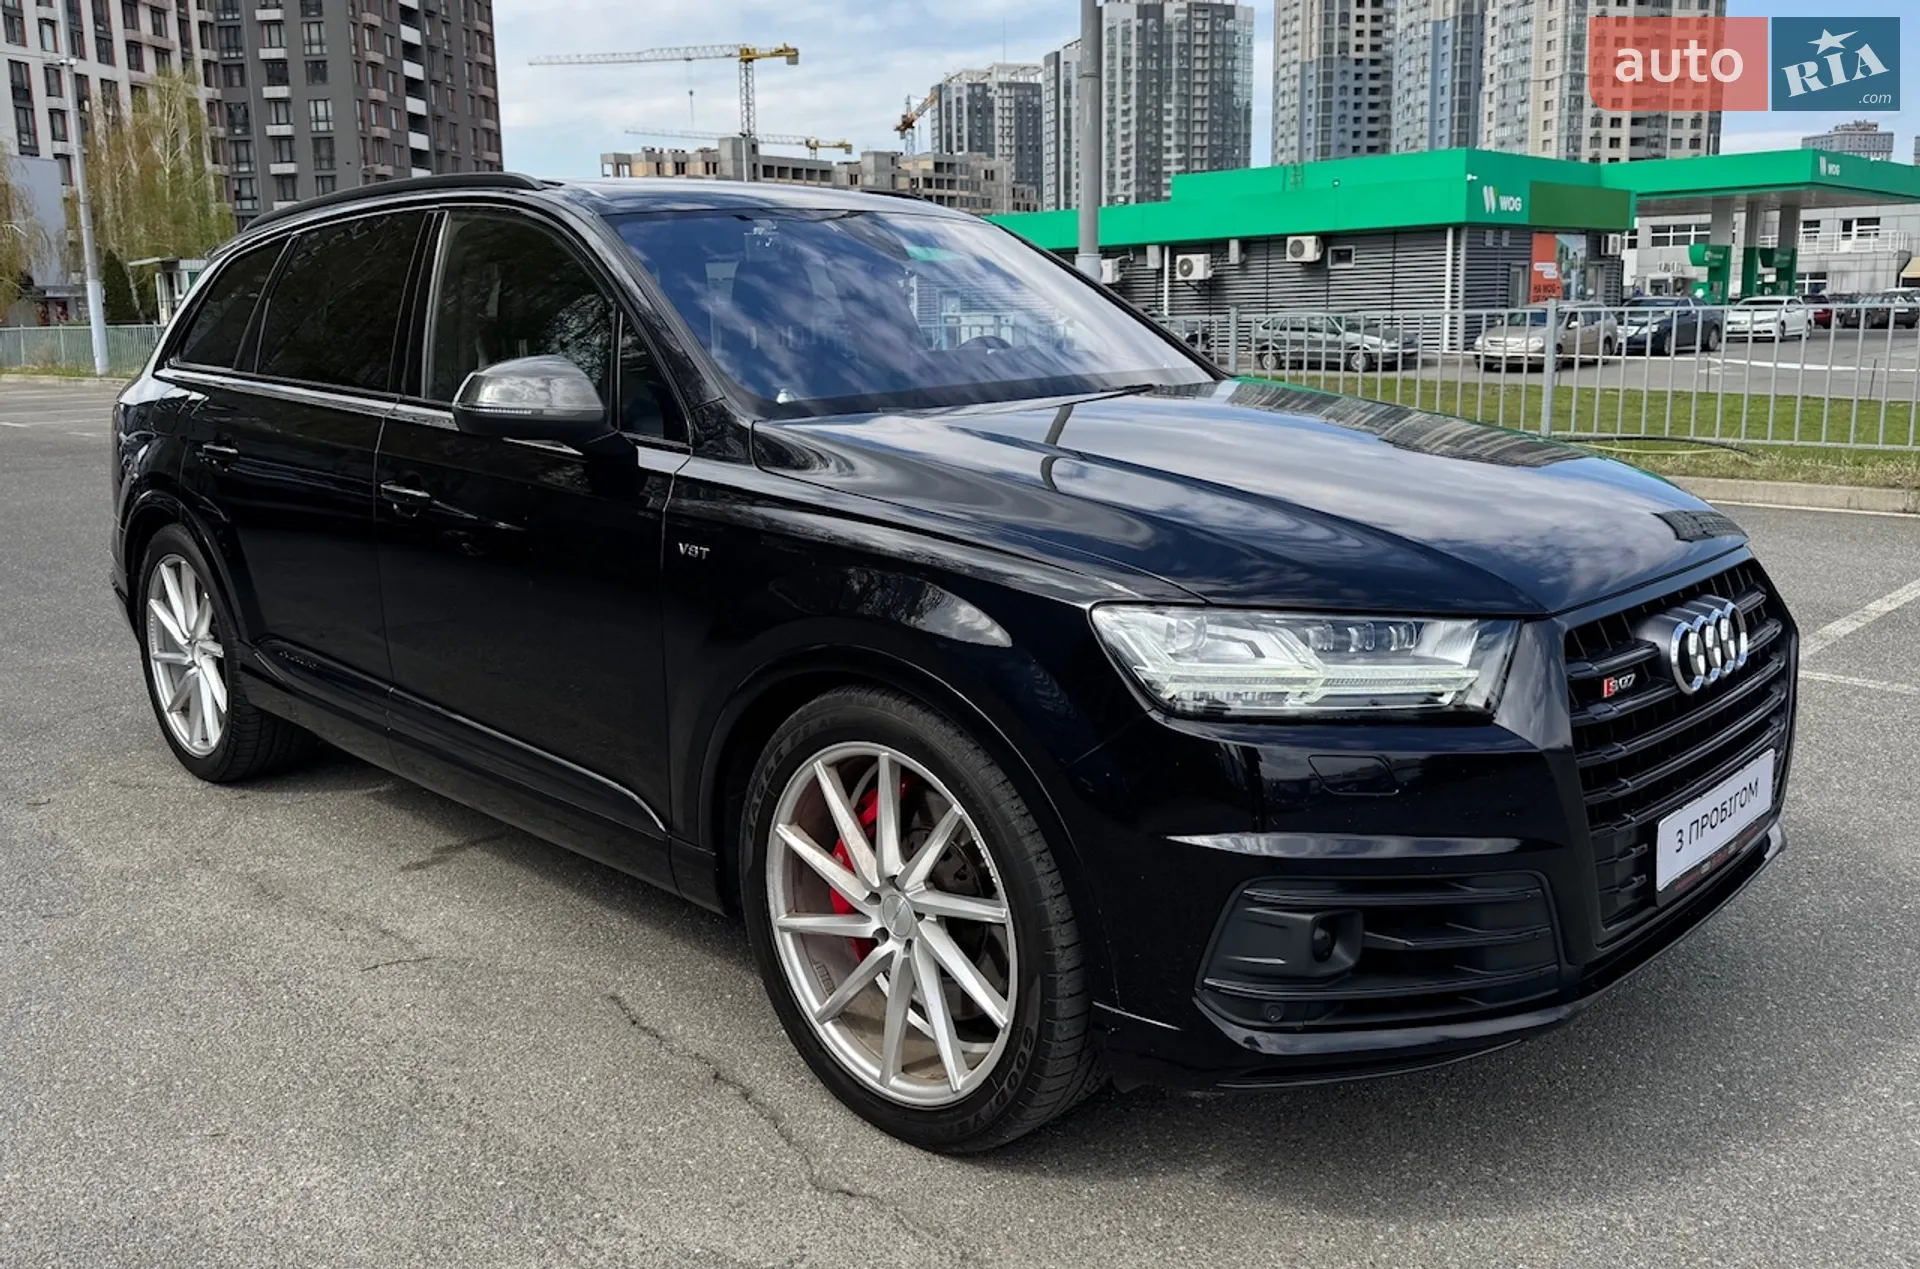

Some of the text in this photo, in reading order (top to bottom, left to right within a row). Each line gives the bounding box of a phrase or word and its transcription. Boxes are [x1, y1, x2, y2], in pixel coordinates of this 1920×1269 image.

[1499, 195, 1522, 212] WOG
[678, 542, 710, 560] V8T
[1688, 776, 1760, 846] ПРОБІГОМ
